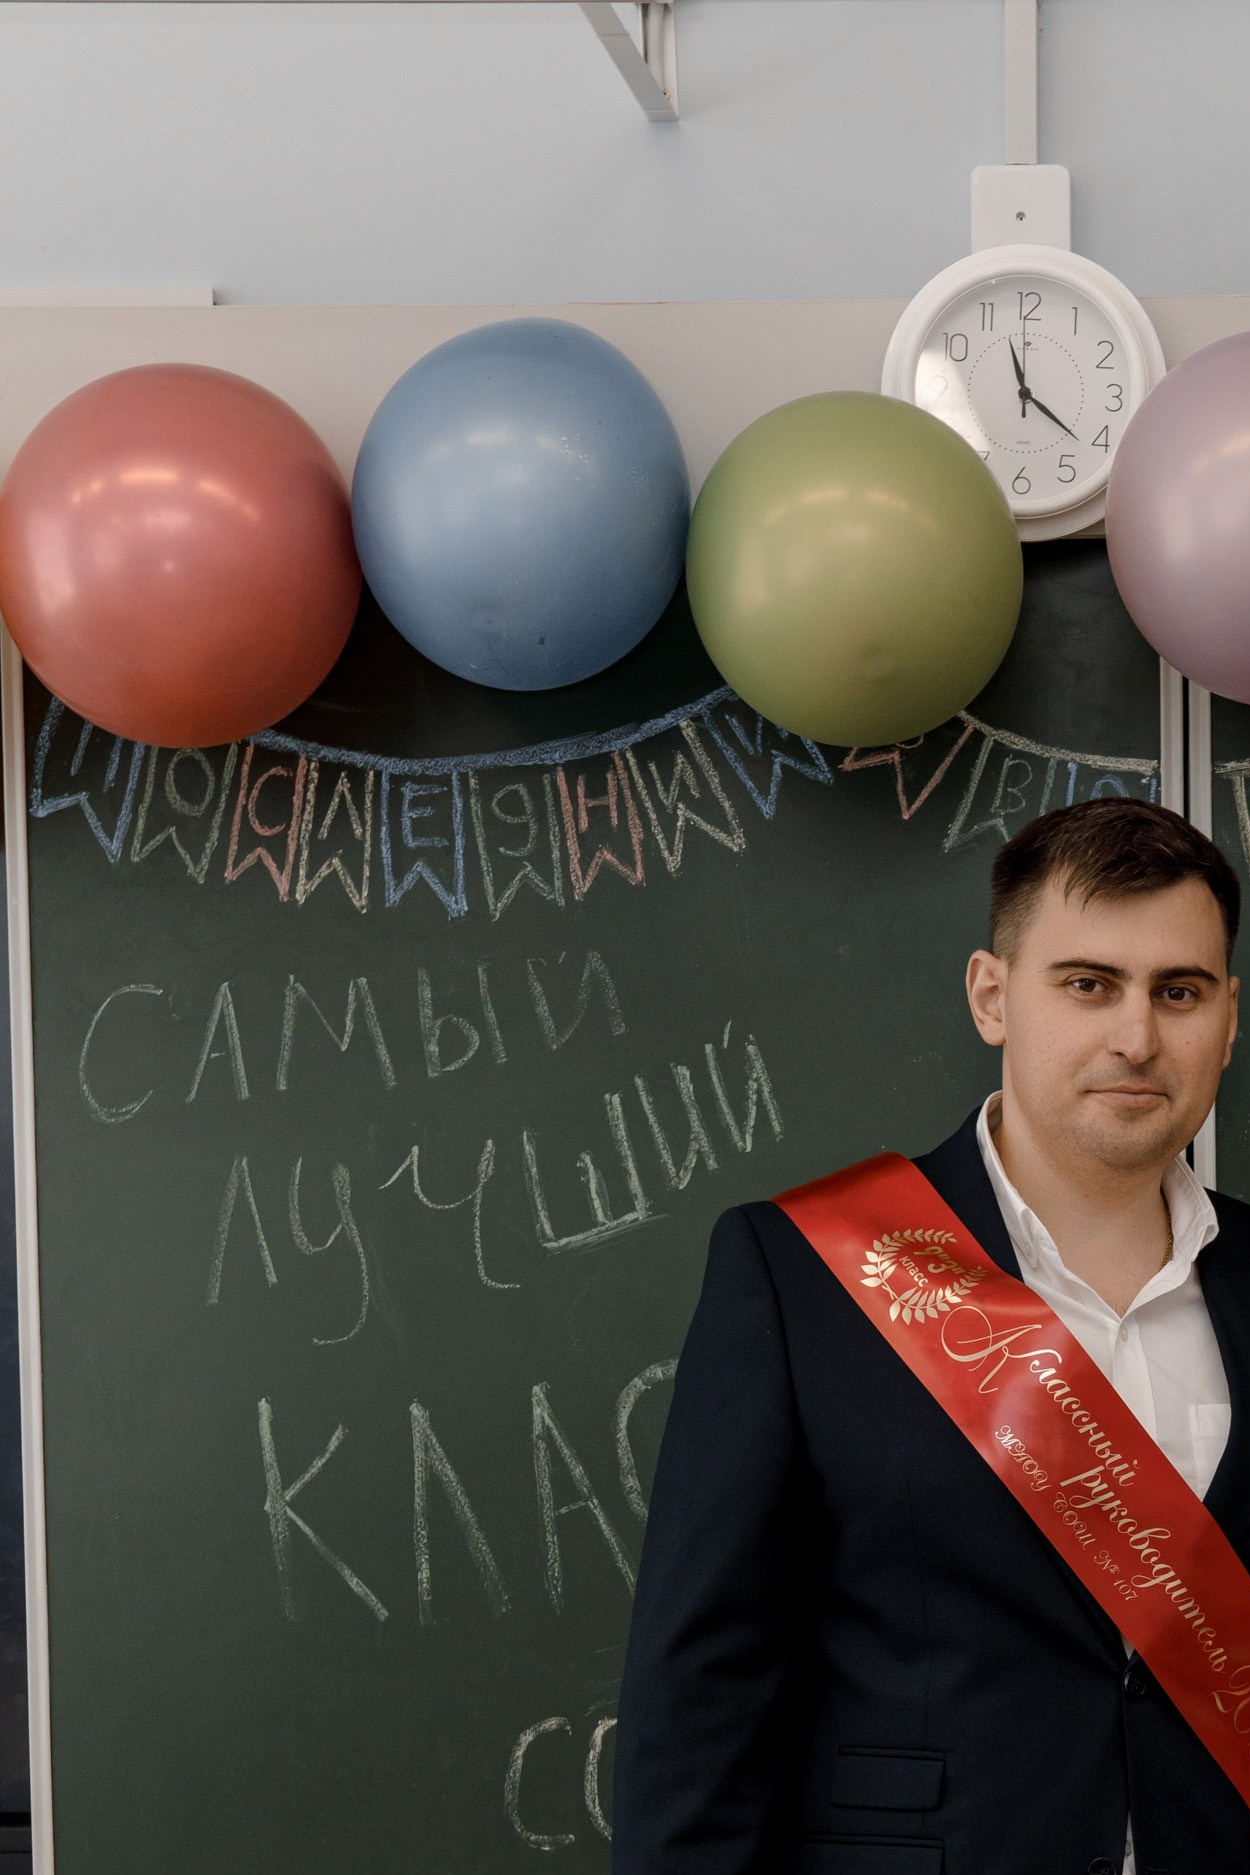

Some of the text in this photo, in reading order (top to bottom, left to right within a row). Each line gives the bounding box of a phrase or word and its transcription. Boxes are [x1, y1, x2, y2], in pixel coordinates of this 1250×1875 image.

[979, 302, 994, 332] 11
[1017, 291, 1042, 321] 12
[1071, 306, 1079, 336] 1
[942, 332, 969, 362] 10
[1095, 340, 1115, 369] 2
[1104, 383, 1124, 412] 3
[1091, 424, 1111, 453] 4
[1011, 466, 1032, 495] 6
[1056, 454, 1076, 483] 5
[79, 950, 627, 1123] САМЫЙ
[206, 1020, 785, 1345] ЛУЧШИЙ
[899, 1256, 929, 1288] класс
[940, 1305, 1137, 1488] Классный
[1060, 1465, 1228, 1674] руководитель
[994, 1425, 1052, 1492] МАОУ
[1053, 1491, 1096, 1550] СОШ
[1114, 1579, 1138, 1601] 107
